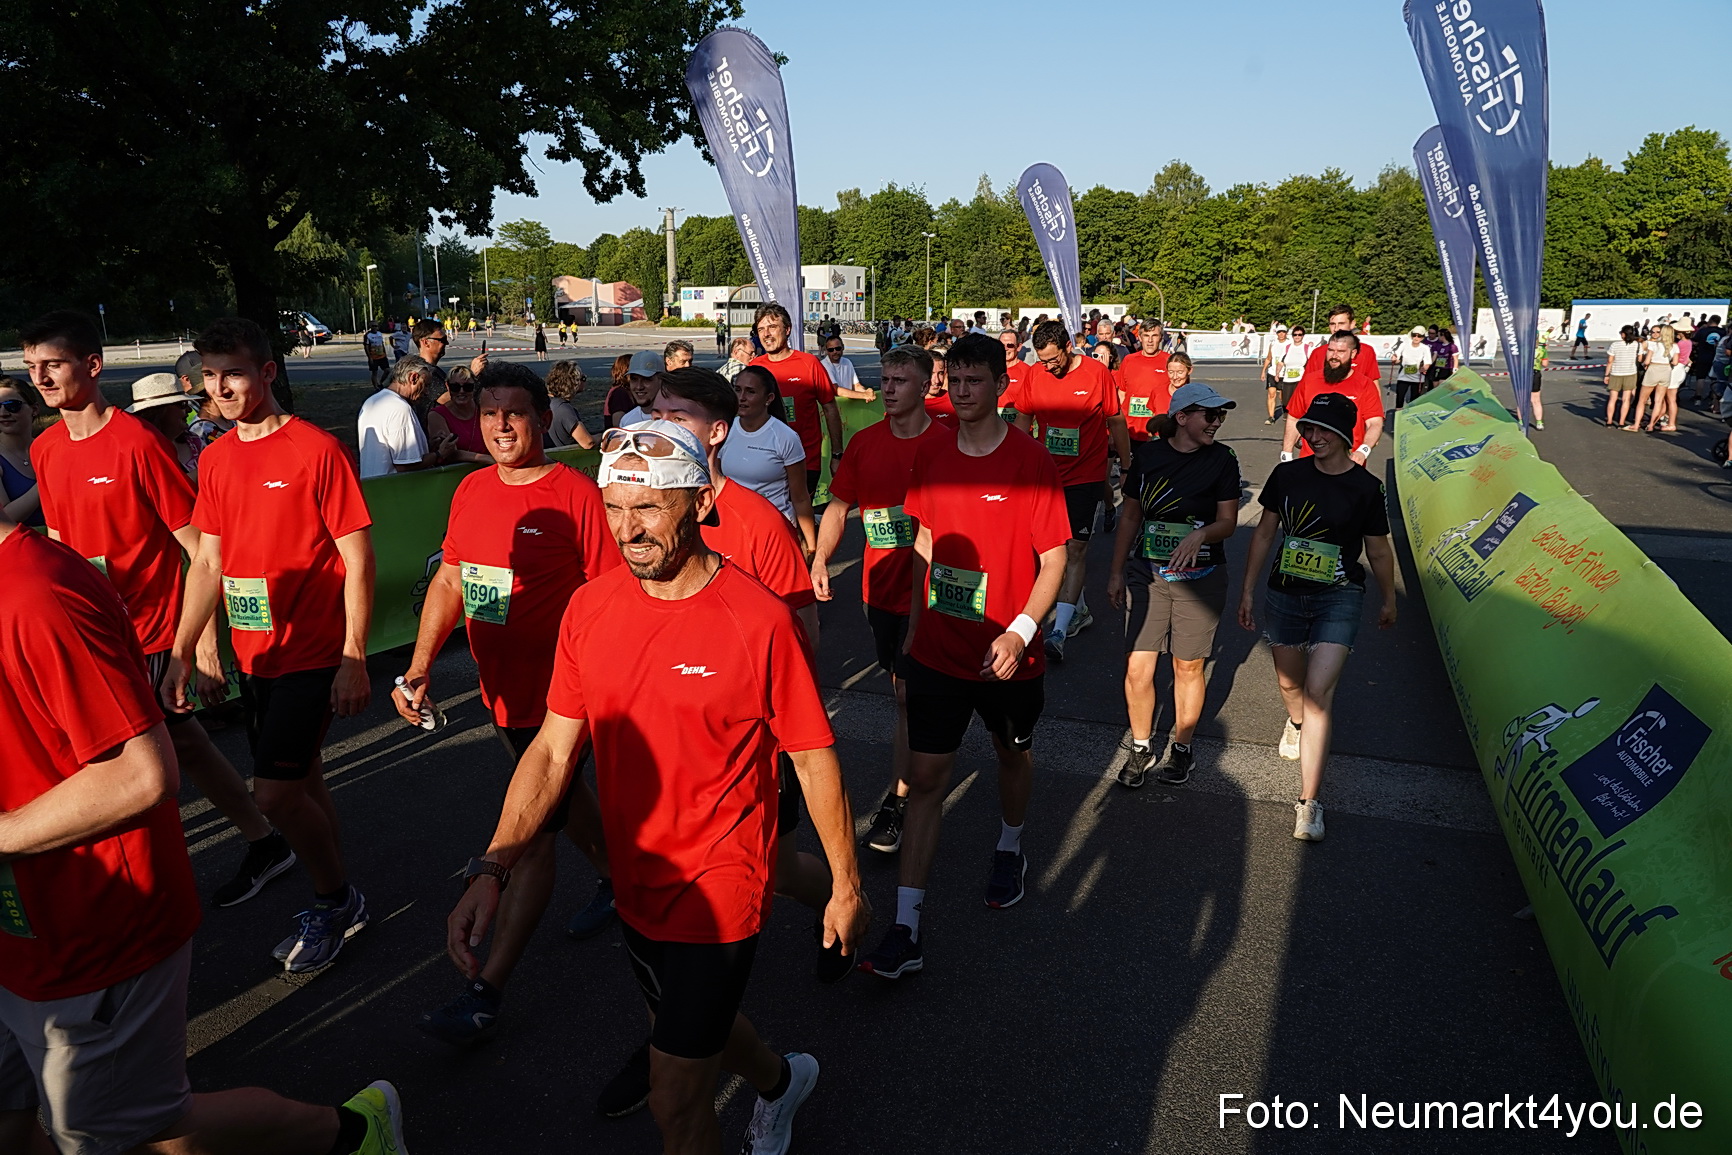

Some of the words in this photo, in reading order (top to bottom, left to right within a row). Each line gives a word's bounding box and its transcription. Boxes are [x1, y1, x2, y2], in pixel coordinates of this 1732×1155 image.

[1049, 436, 1073, 446] 1730
[871, 520, 904, 536] 1686
[1154, 534, 1180, 549] 666
[1295, 551, 1322, 569] 671
[1326, 560, 1335, 578] 2022
[1531, 524, 1589, 565] Gesunde
[1572, 551, 1621, 594] Firmen
[228, 594, 260, 613] 1698
[464, 581, 499, 604] 1690
[937, 580, 976, 604] 1687
[975, 591, 983, 615] 2022
[1513, 562, 1554, 603] laufen
[1538, 585, 1600, 635] länger!
[259, 599, 269, 623] 2022
[1624, 726, 1674, 778] Fischer
[1615, 750, 1654, 788] AUTOMOBILE
[1512, 810, 1549, 888] neumarkt
[1517, 748, 1680, 969] firmenlauf
[2, 890, 24, 927] 2022
